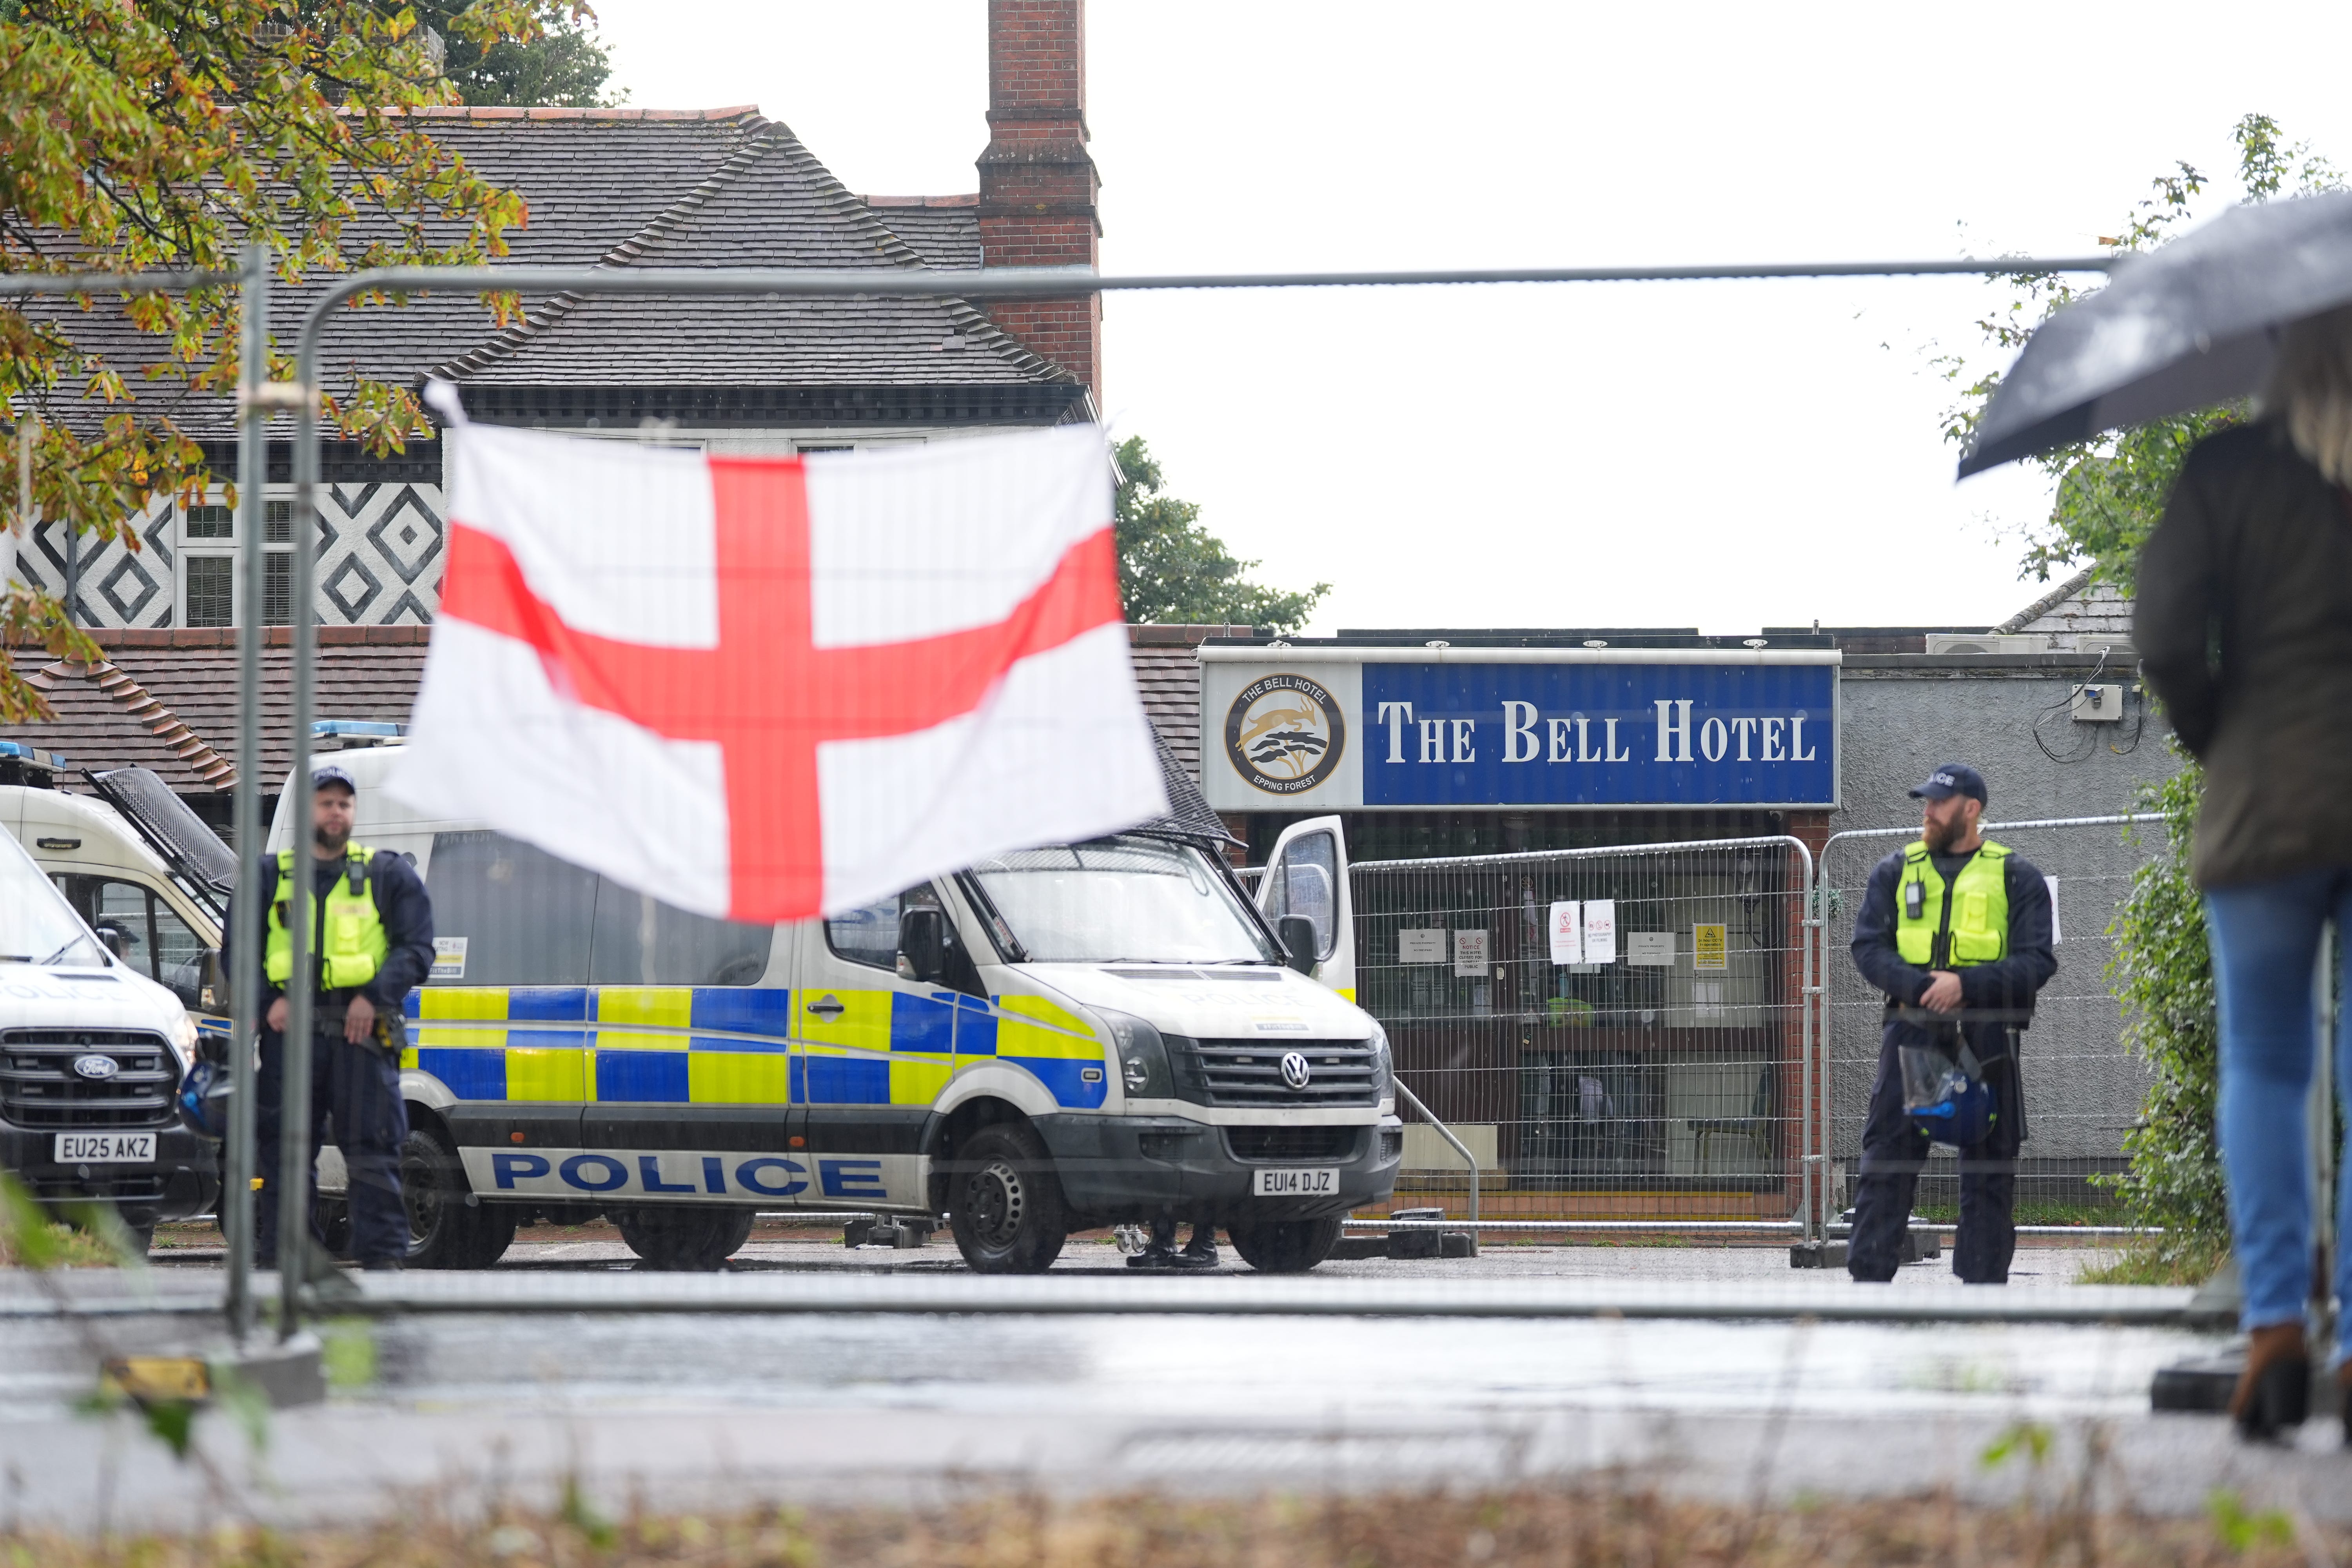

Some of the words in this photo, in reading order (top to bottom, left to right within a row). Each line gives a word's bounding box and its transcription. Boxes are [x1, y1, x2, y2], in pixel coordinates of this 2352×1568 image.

[1242, 684, 1264, 702] THE
[1263, 677, 1292, 690] BELL
[1294, 679, 1327, 704] HOTEL
[1378, 701, 1475, 763] THE
[1501, 701, 1630, 762] BELL
[1654, 699, 1816, 762] HOTEL
[1253, 775, 1283, 791] EPPING
[1285, 775, 1316, 791] FOREST
[0, 985, 132, 1001] OLICE
[82, 1060, 110, 1074] Ford
[64, 1138, 109, 1158] EU25
[115, 1138, 149, 1157] AKZ
[492, 1154, 887, 1198] POLICE
[1264, 1173, 1297, 1191] EU14
[1302, 1172, 1330, 1191] DJZ
